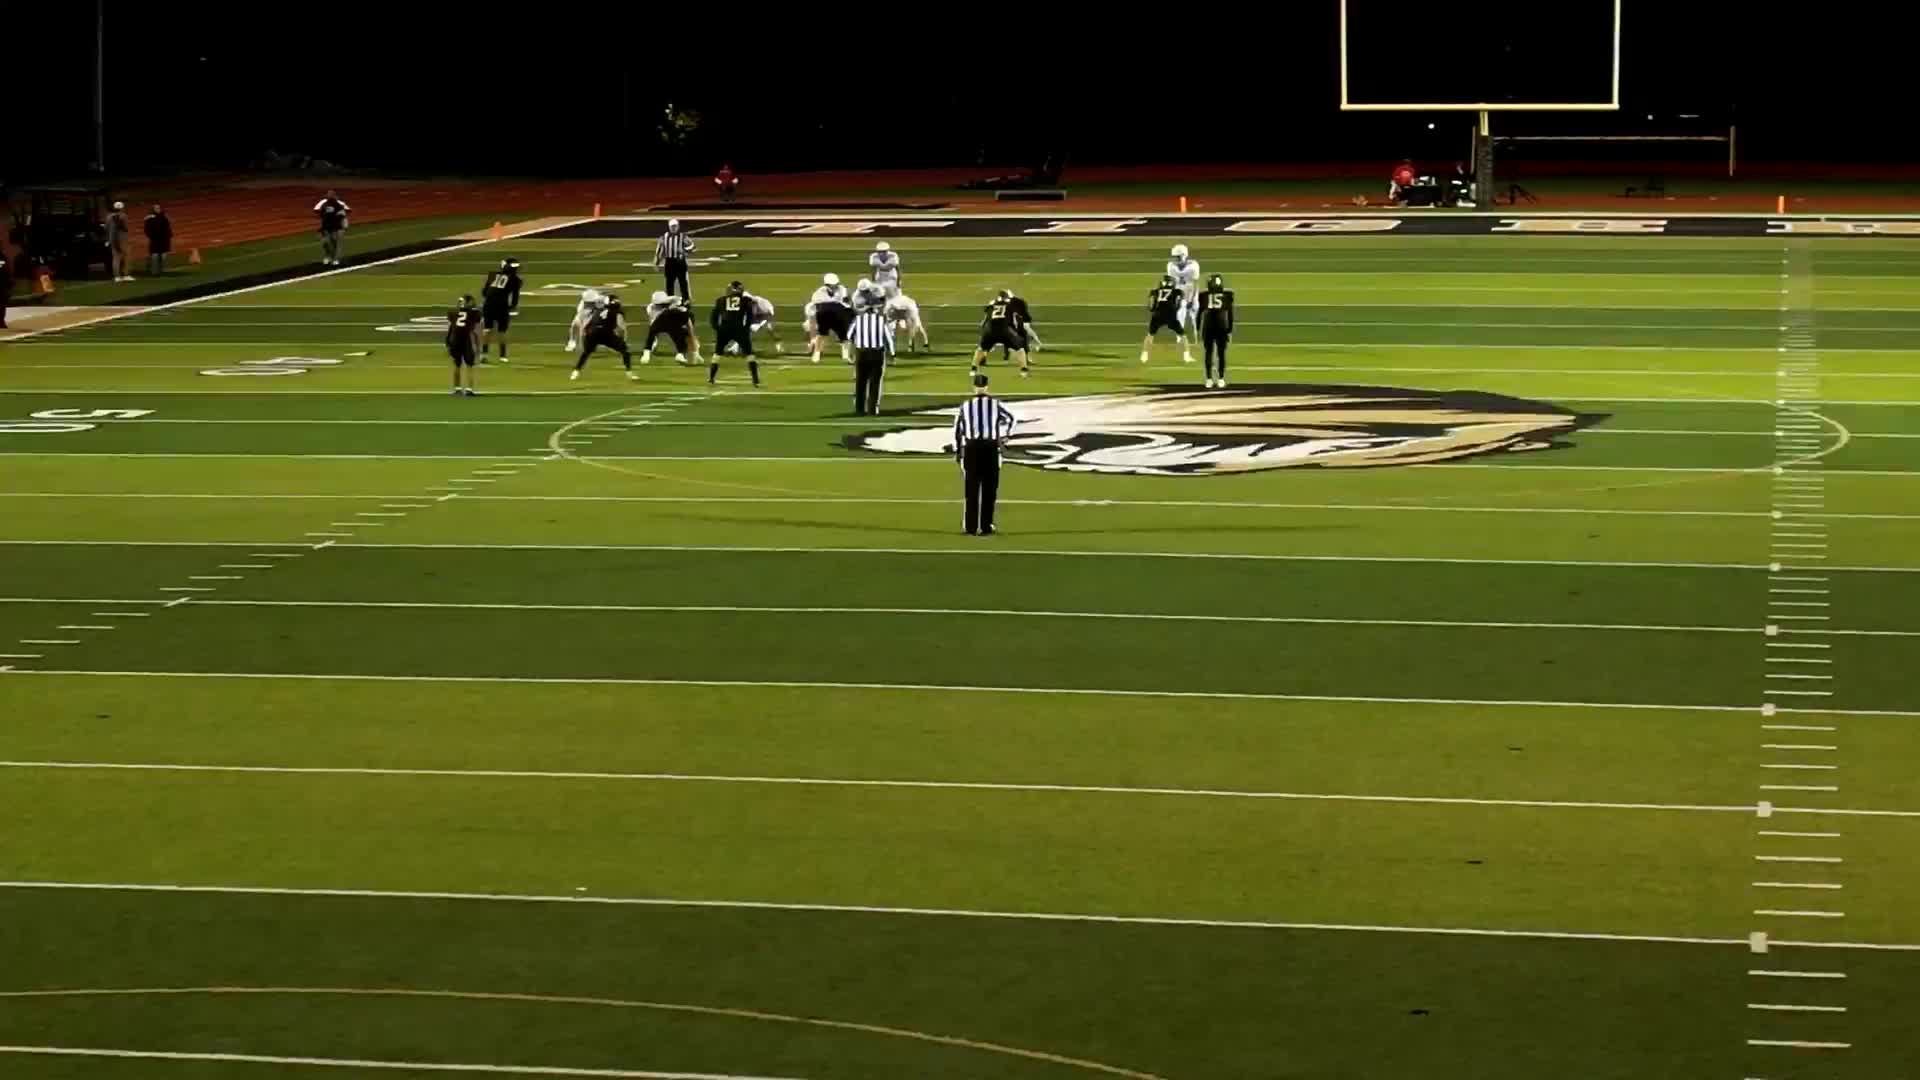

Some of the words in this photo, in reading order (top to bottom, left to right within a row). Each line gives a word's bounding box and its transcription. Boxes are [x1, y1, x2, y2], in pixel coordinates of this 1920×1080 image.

[492, 273, 509, 289] 10
[1158, 289, 1173, 302] 17
[1207, 294, 1224, 309] 15
[726, 297, 741, 311] 12
[456, 311, 468, 327] 2
[992, 305, 1007, 319] 21
